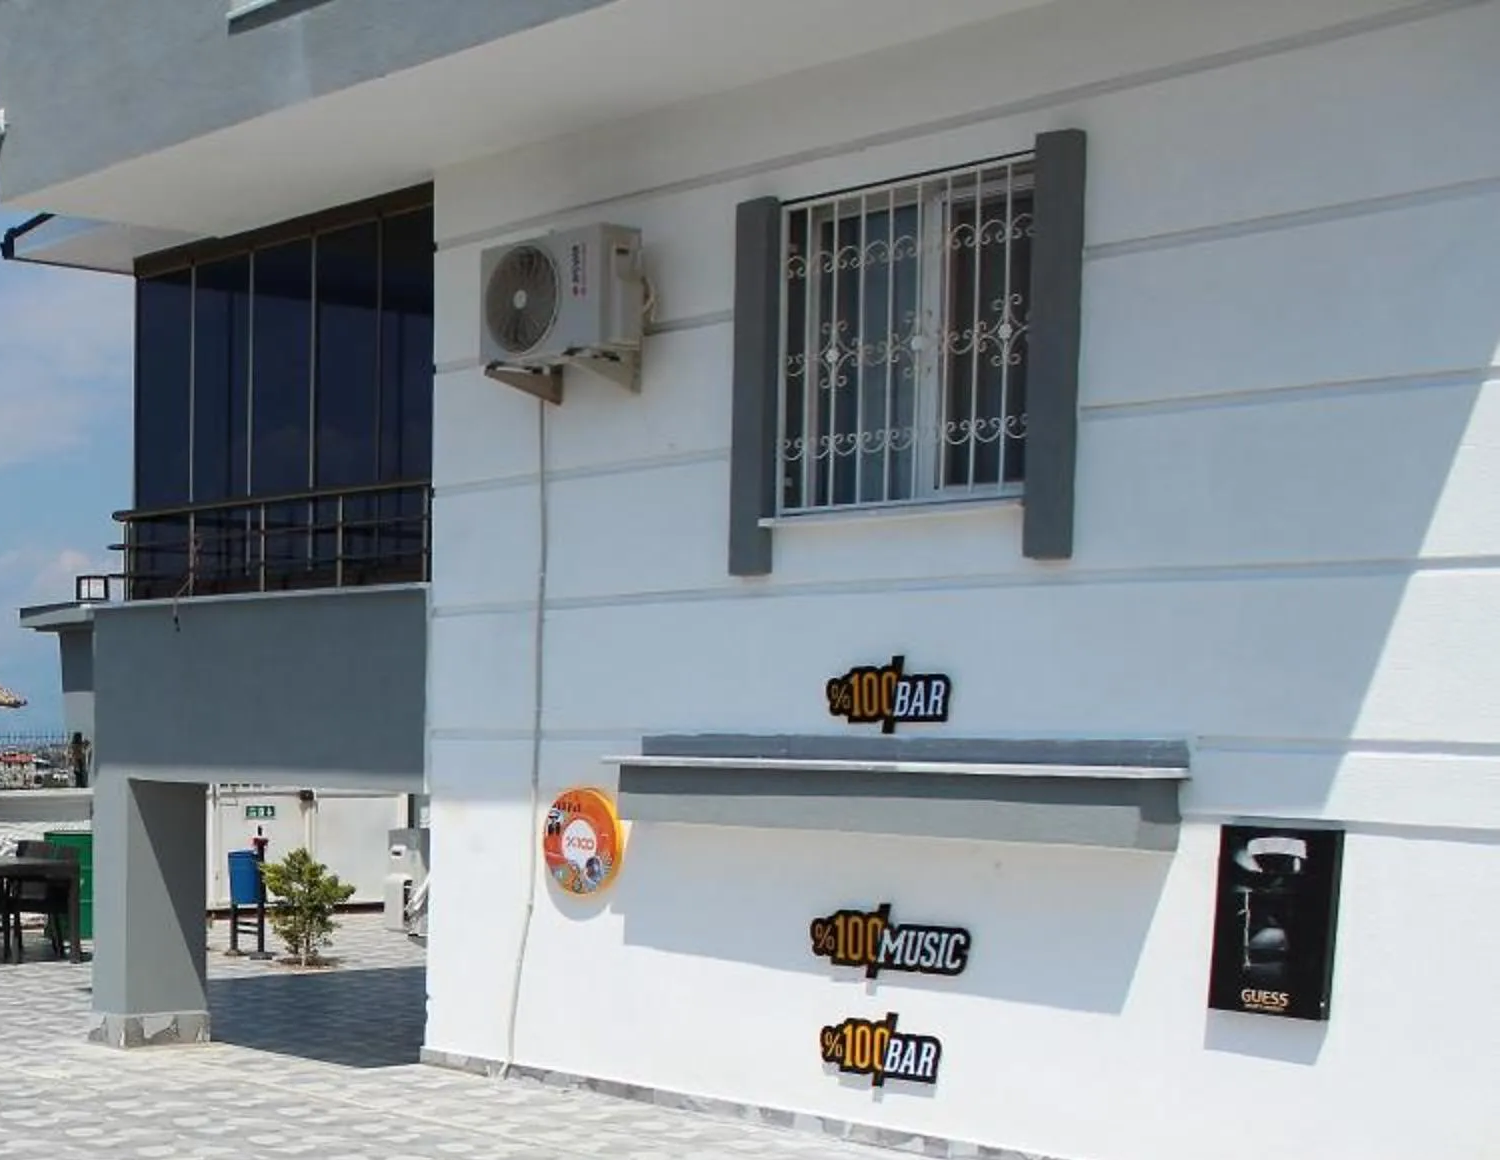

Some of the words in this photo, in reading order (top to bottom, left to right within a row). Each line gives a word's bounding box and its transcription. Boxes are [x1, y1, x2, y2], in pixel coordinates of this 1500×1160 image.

[894, 680, 945, 717] BAR
[877, 927, 966, 969] MUSIC
[1241, 988, 1290, 1008] GUESS
[884, 1039, 937, 1077] BAR
